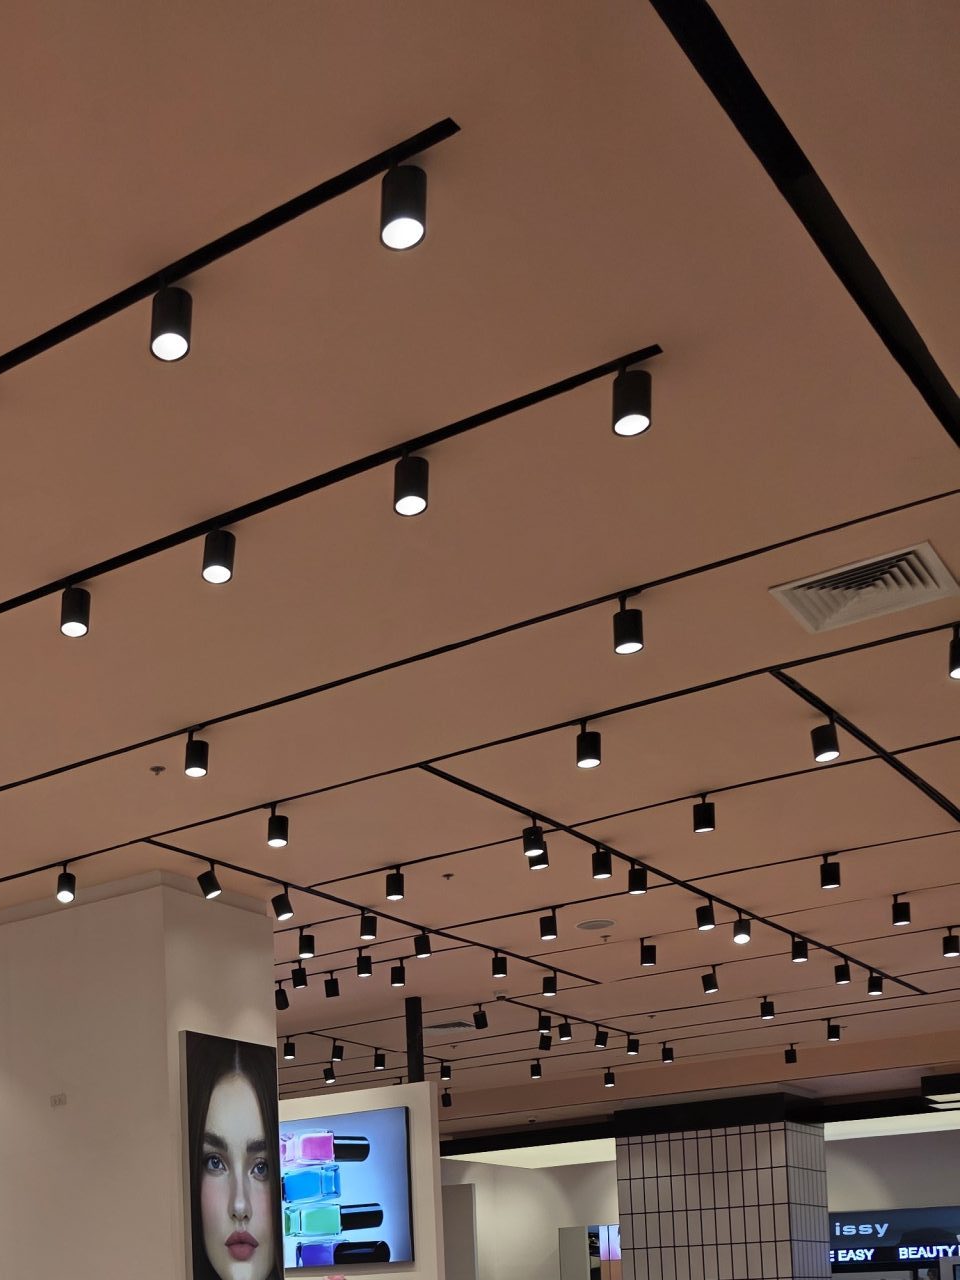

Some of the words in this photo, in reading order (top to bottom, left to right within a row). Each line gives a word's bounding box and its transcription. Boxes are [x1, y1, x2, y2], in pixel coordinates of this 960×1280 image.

[835, 1222, 889, 1238] issy
[838, 1248, 875, 1262] EASY
[898, 1245, 957, 1260] BEAUTY
